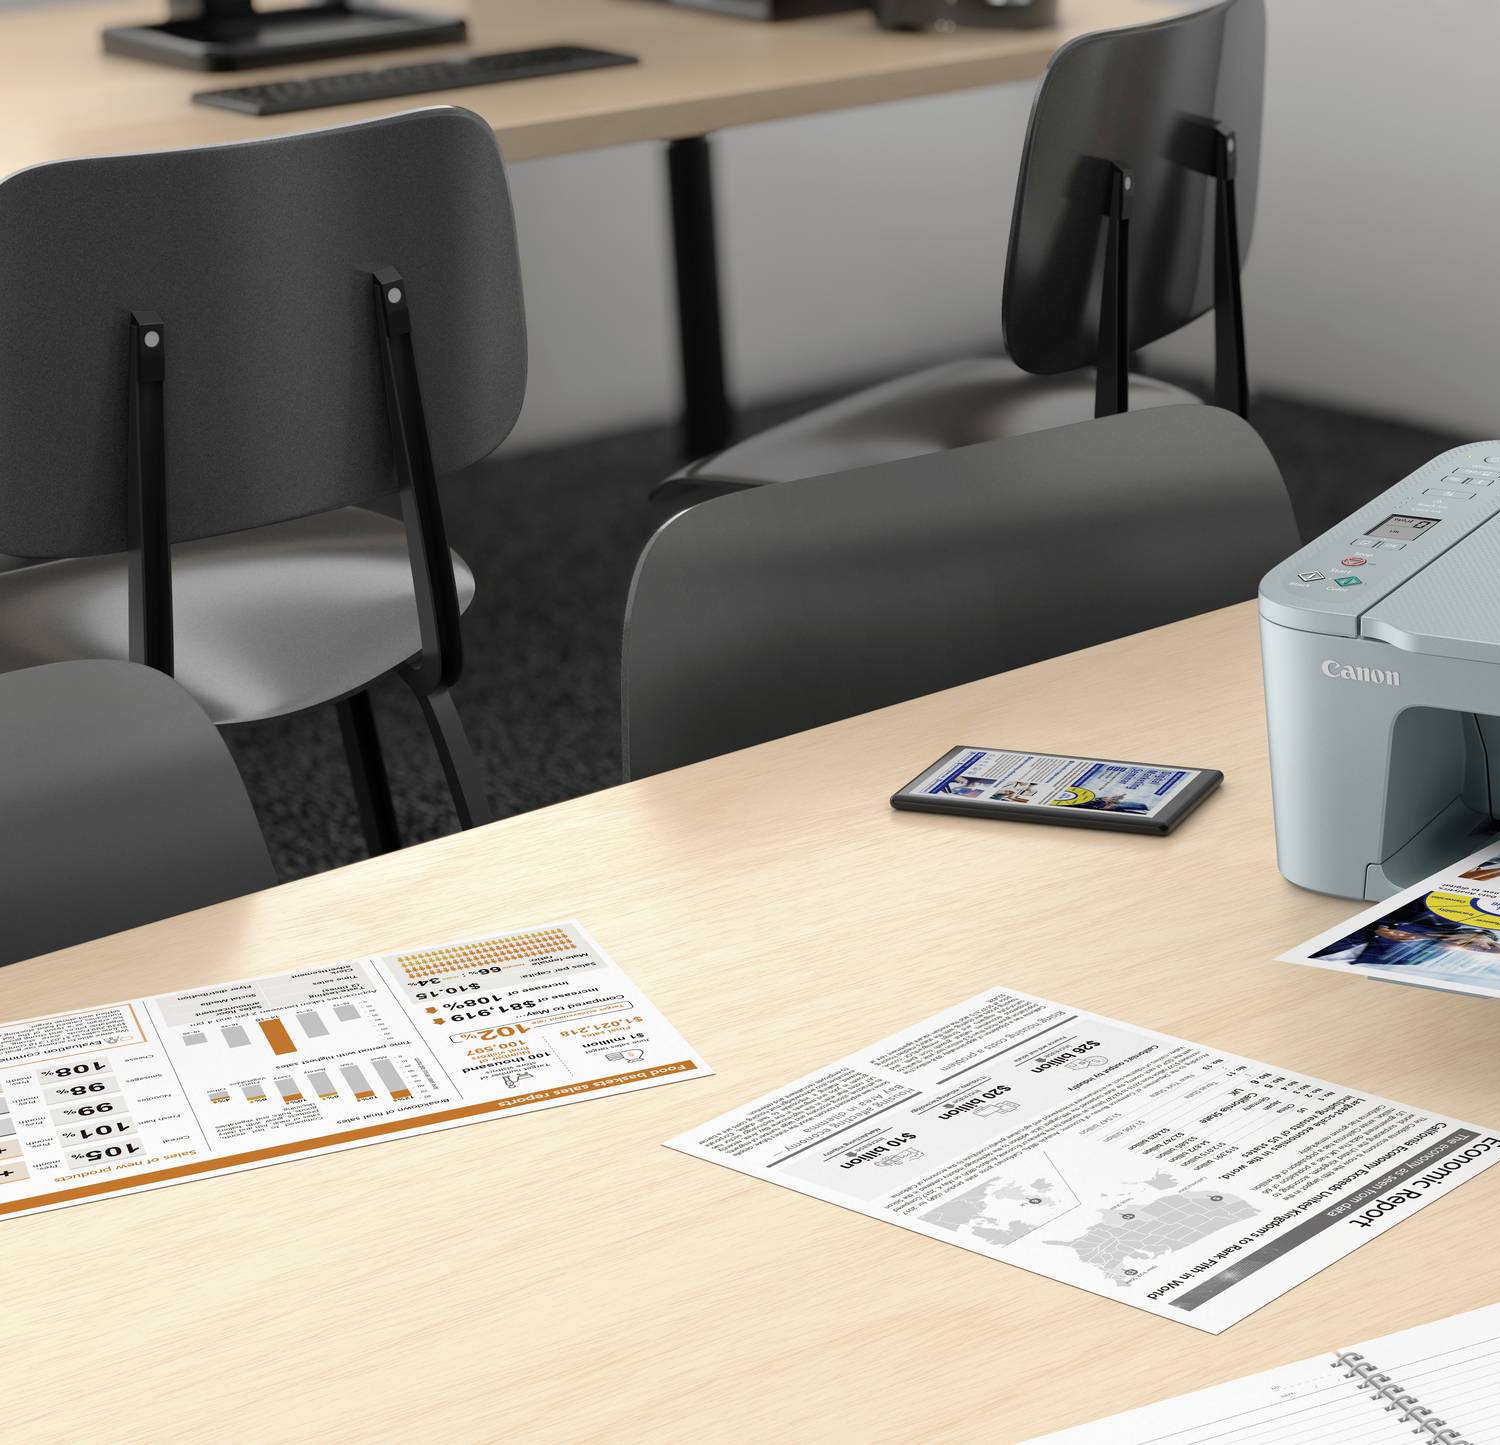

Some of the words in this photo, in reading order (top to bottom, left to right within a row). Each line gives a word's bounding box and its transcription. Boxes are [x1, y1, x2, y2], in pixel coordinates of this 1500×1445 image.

[1321, 659, 1400, 686] Canon
[467, 965, 502, 976] 66%
[406, 977, 441, 987] 34%
[521, 980, 569, 992] Increase
[414, 982, 481, 1000] $10.15
[550, 987, 599, 999] Increase
[441, 994, 503, 1011] 108%
[566, 994, 625, 1009] Compared
[449, 999, 537, 1022] $81,919
[1036, 1010, 1066, 1023] Rising
[457, 1022, 531, 1042] 102%
[558, 1015, 643, 1037] $1,021,218
[1003, 1021, 1042, 1039] housing
[42, 1039, 102, 1054] Evaluation
[464, 1038, 527, 1056] 100,597
[581, 1036, 626, 1048] million
[982, 1037, 1009, 1050] costs
[1070, 1039, 1101, 1054] $26
[527, 1051, 551, 1060] 100
[938, 1051, 979, 1071] problem
[1029, 1052, 1077, 1073] billion
[40, 1060, 106, 1079] 108%
[460, 1056, 525, 1073] thousand
[648, 1063, 687, 1076] Food
[591, 1071, 647, 1087] baskets
[55, 1081, 105, 1097] 98%
[552, 1083, 590, 1095] sales
[880, 1083, 905, 1094] Bay
[980, 1084, 1012, 1099] $20
[396, 1098, 450, 1112] Breakdown
[496, 1091, 550, 1107] reports
[857, 1093, 884, 1106] Area
[871, 1087, 916, 1107] Housing
[1313, 1094, 1355, 1115] including
[62, 1101, 113, 1118] 99%
[361, 1111, 383, 1119] final
[936, 1097, 986, 1120] billion
[1310, 1097, 1366, 1127] Largest-scale
[335, 1116, 361, 1124] sales
[801, 1111, 848, 1133] dilemma
[828, 1106, 875, 1128] affecting
[1288, 1114, 1319, 1130] results
[61, 1121, 130, 1141] 101%
[782, 1127, 832, 1151] economy
[884, 1131, 917, 1147] $10
[1269, 1126, 1315, 1151] economies
[1402, 1121, 1448, 1146] California
[1445, 1133, 1470, 1144] The
[70, 1142, 140, 1163] 105%
[162, 1149, 197, 1160] Sales
[838, 1145, 890, 1169] billion
[1240, 1142, 1269, 1158] states
[1361, 1144, 1408, 1170] Economy
[1403, 1143, 1450, 1169] economy
[114, 1160, 143, 1170] new
[1245, 1155, 1264, 1165] the
[53, 1165, 112, 1183] products
[1217, 1163, 1249, 1180] world,
[1326, 1168, 1369, 1191] Exceeds
[1370, 1174, 1398, 1189] seen
[1296, 1190, 1333, 1210] United
[1348, 1188, 1377, 1203] from
[1325, 1202, 1353, 1217] data
[1345, 1187, 1422, 1228] Report
[1247, 1208, 1302, 1238] Kingdom's
[1212, 1244, 1242, 1259] Rank
[1188, 1258, 1218, 1273] Fifth
[1145, 1279, 1184, 1300] World
